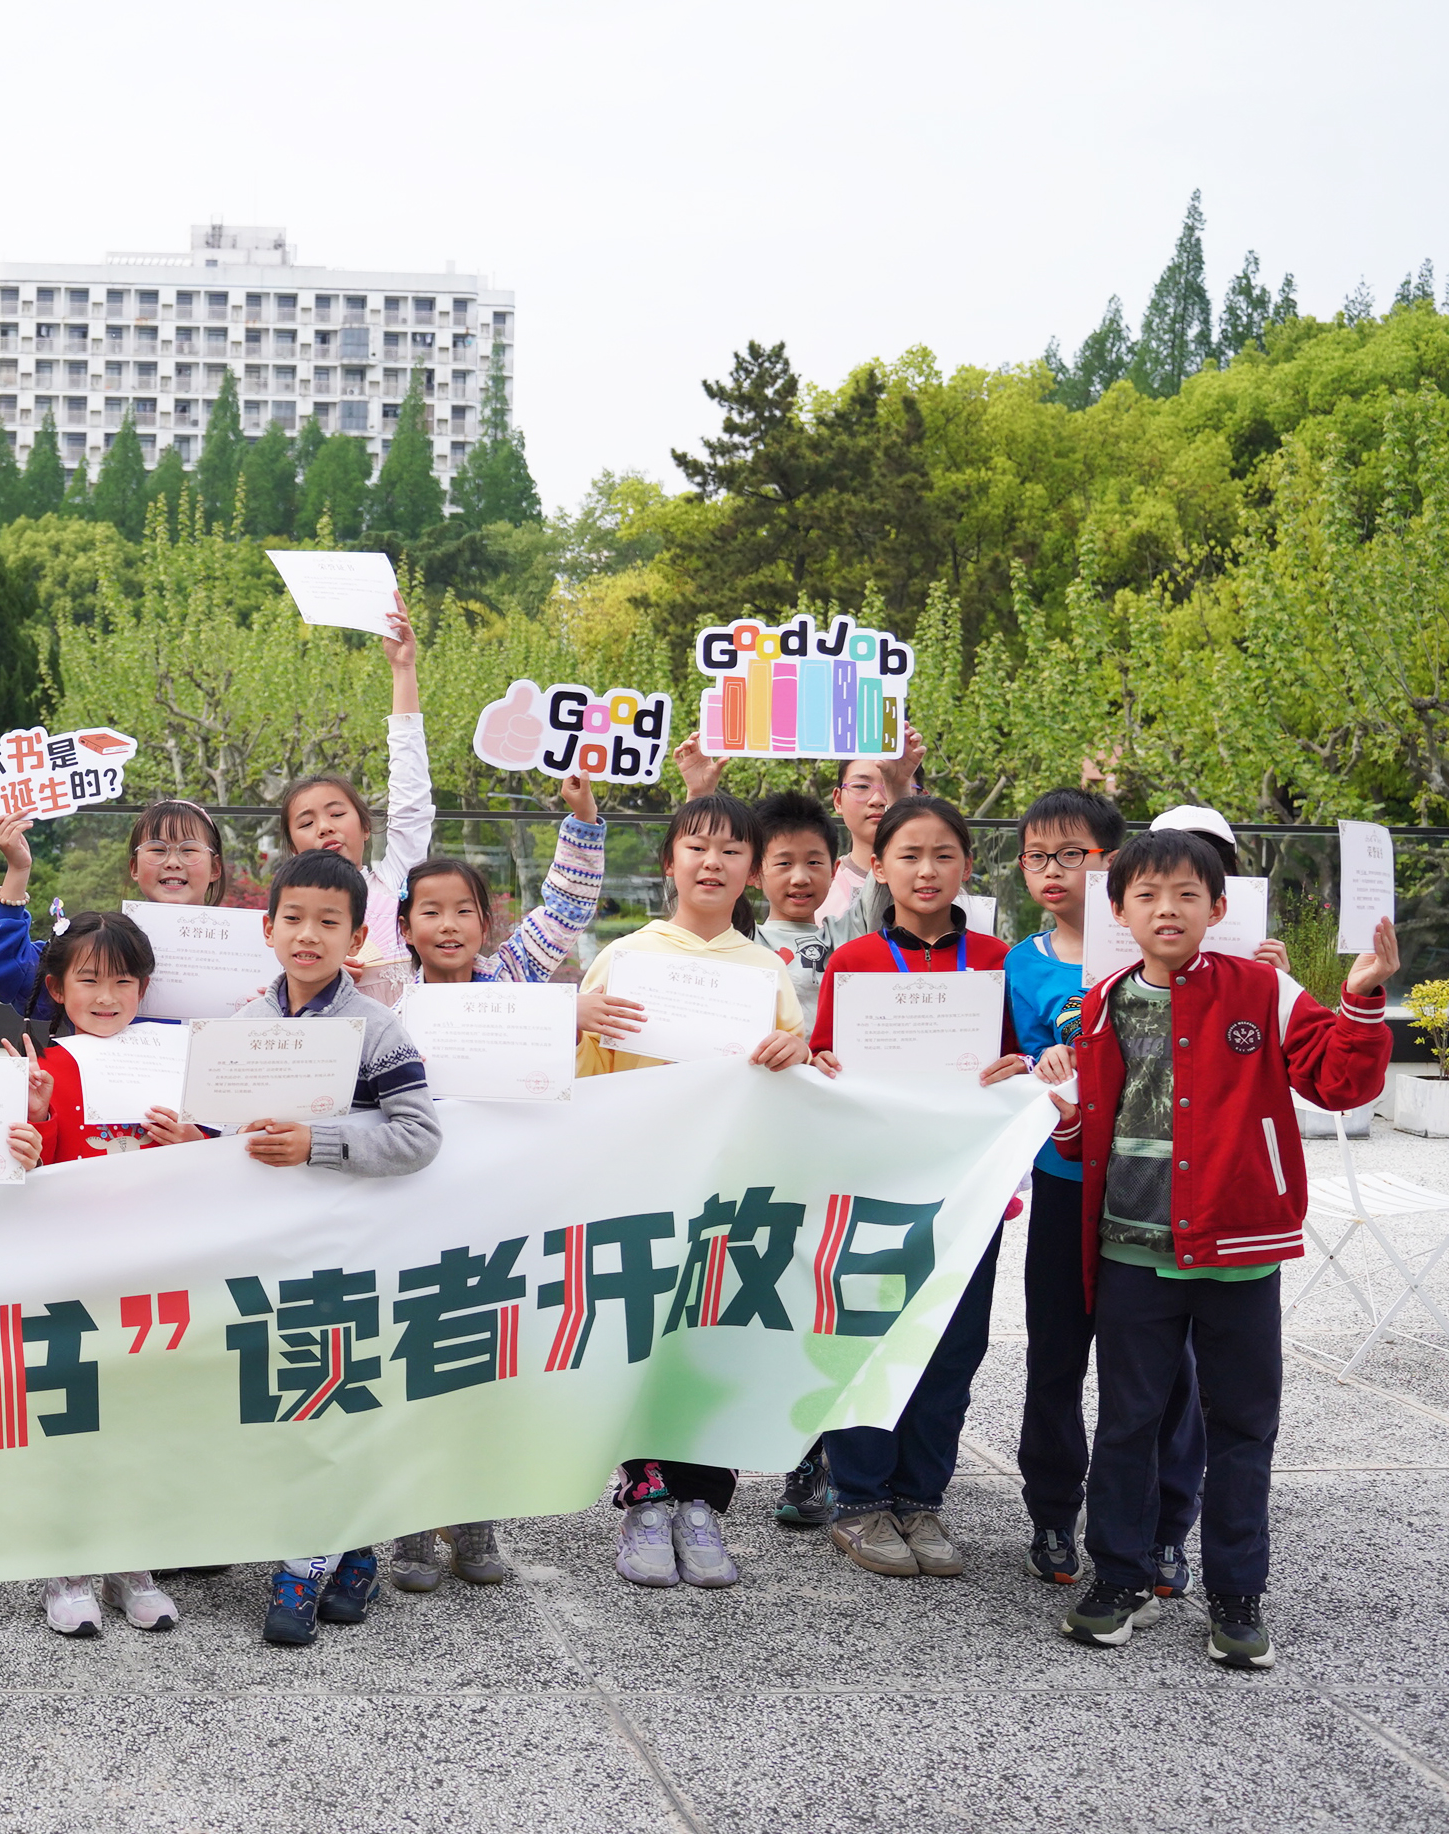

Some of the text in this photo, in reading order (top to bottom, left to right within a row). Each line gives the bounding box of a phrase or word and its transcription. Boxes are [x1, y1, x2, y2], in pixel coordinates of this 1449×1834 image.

[703, 620, 907, 676] Good Job
[549, 690, 665, 740] Good
[543, 733, 660, 777] Job!
[178, 926, 230, 941] 荣誉证书
[668, 971, 719, 989] 荣誉证书
[895, 992, 947, 1005] 荣誉证书
[463, 1001, 517, 1014] 荣誉证书
[249, 1038, 304, 1051] 荣誉证书
